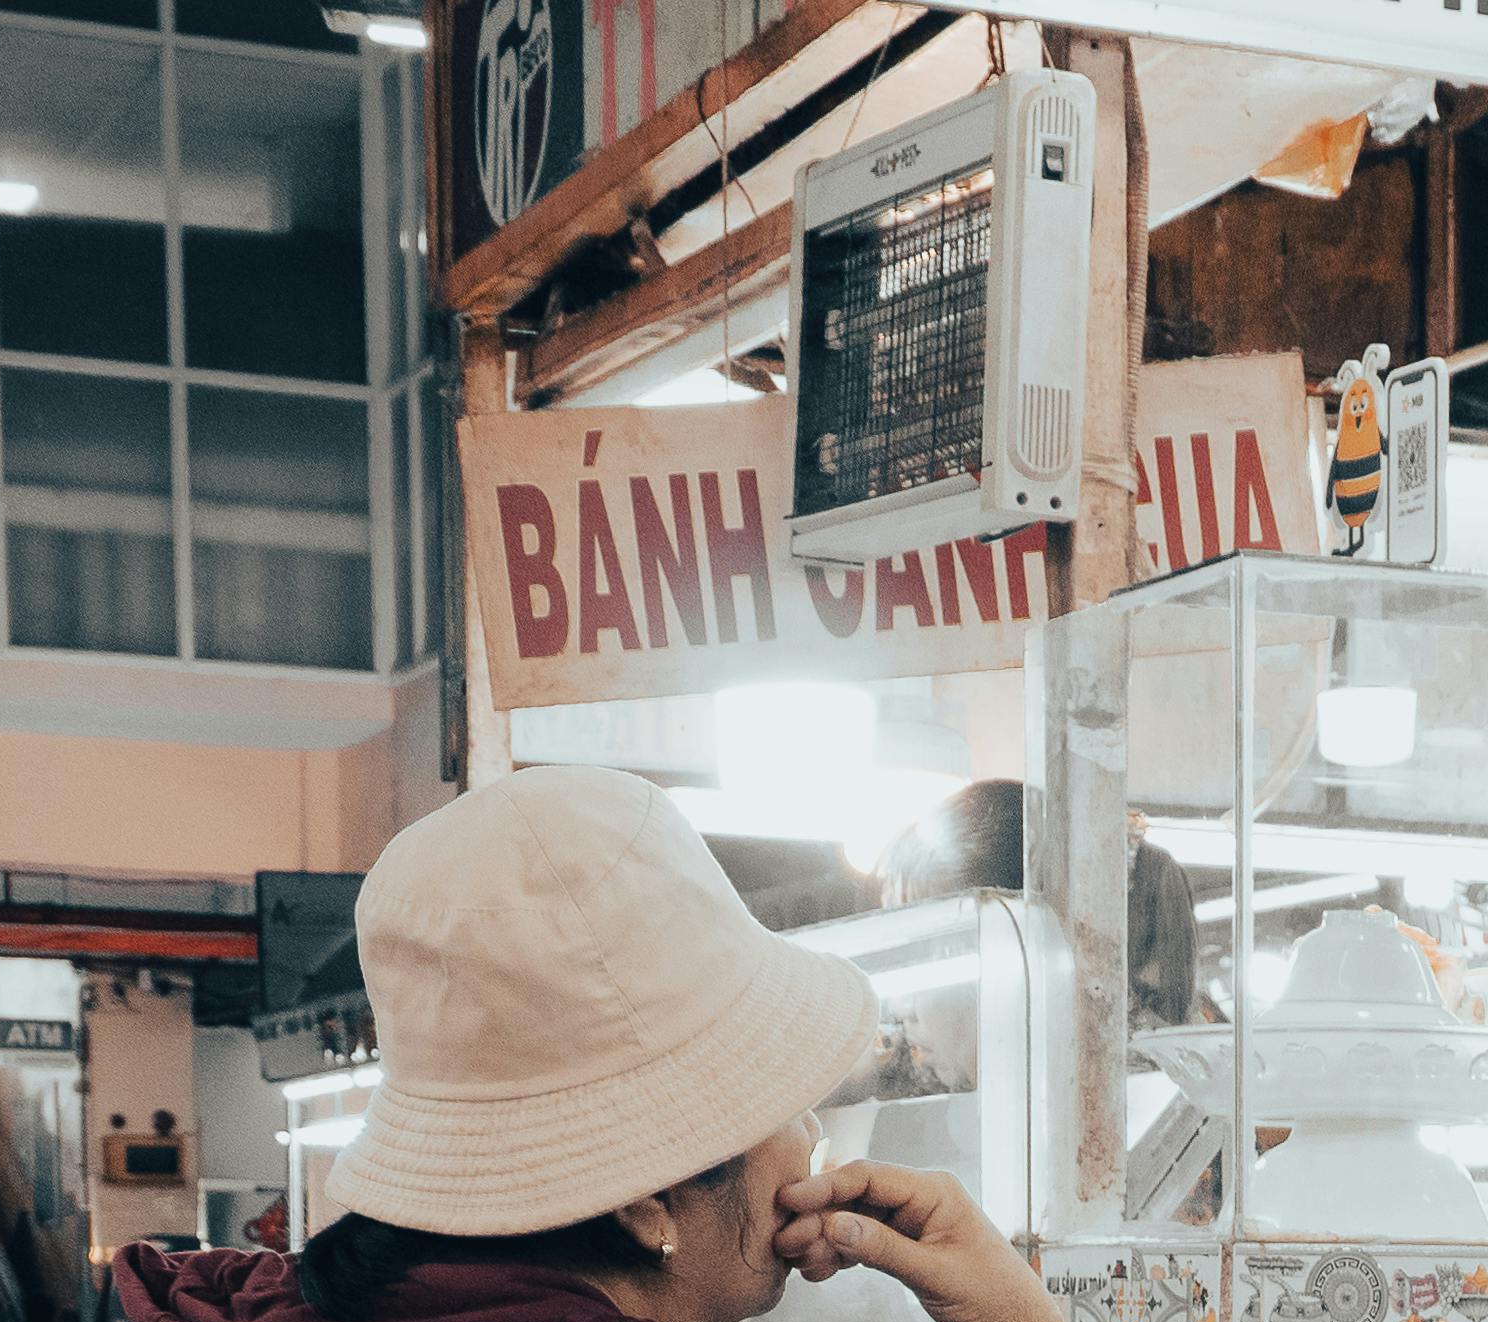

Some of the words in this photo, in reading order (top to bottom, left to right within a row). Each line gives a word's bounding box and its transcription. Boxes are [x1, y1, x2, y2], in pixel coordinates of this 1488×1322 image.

[496, 429, 778, 659] BÁNH
[1135, 428, 1284, 572] UA
[5, 1022, 64, 1047] ATM
